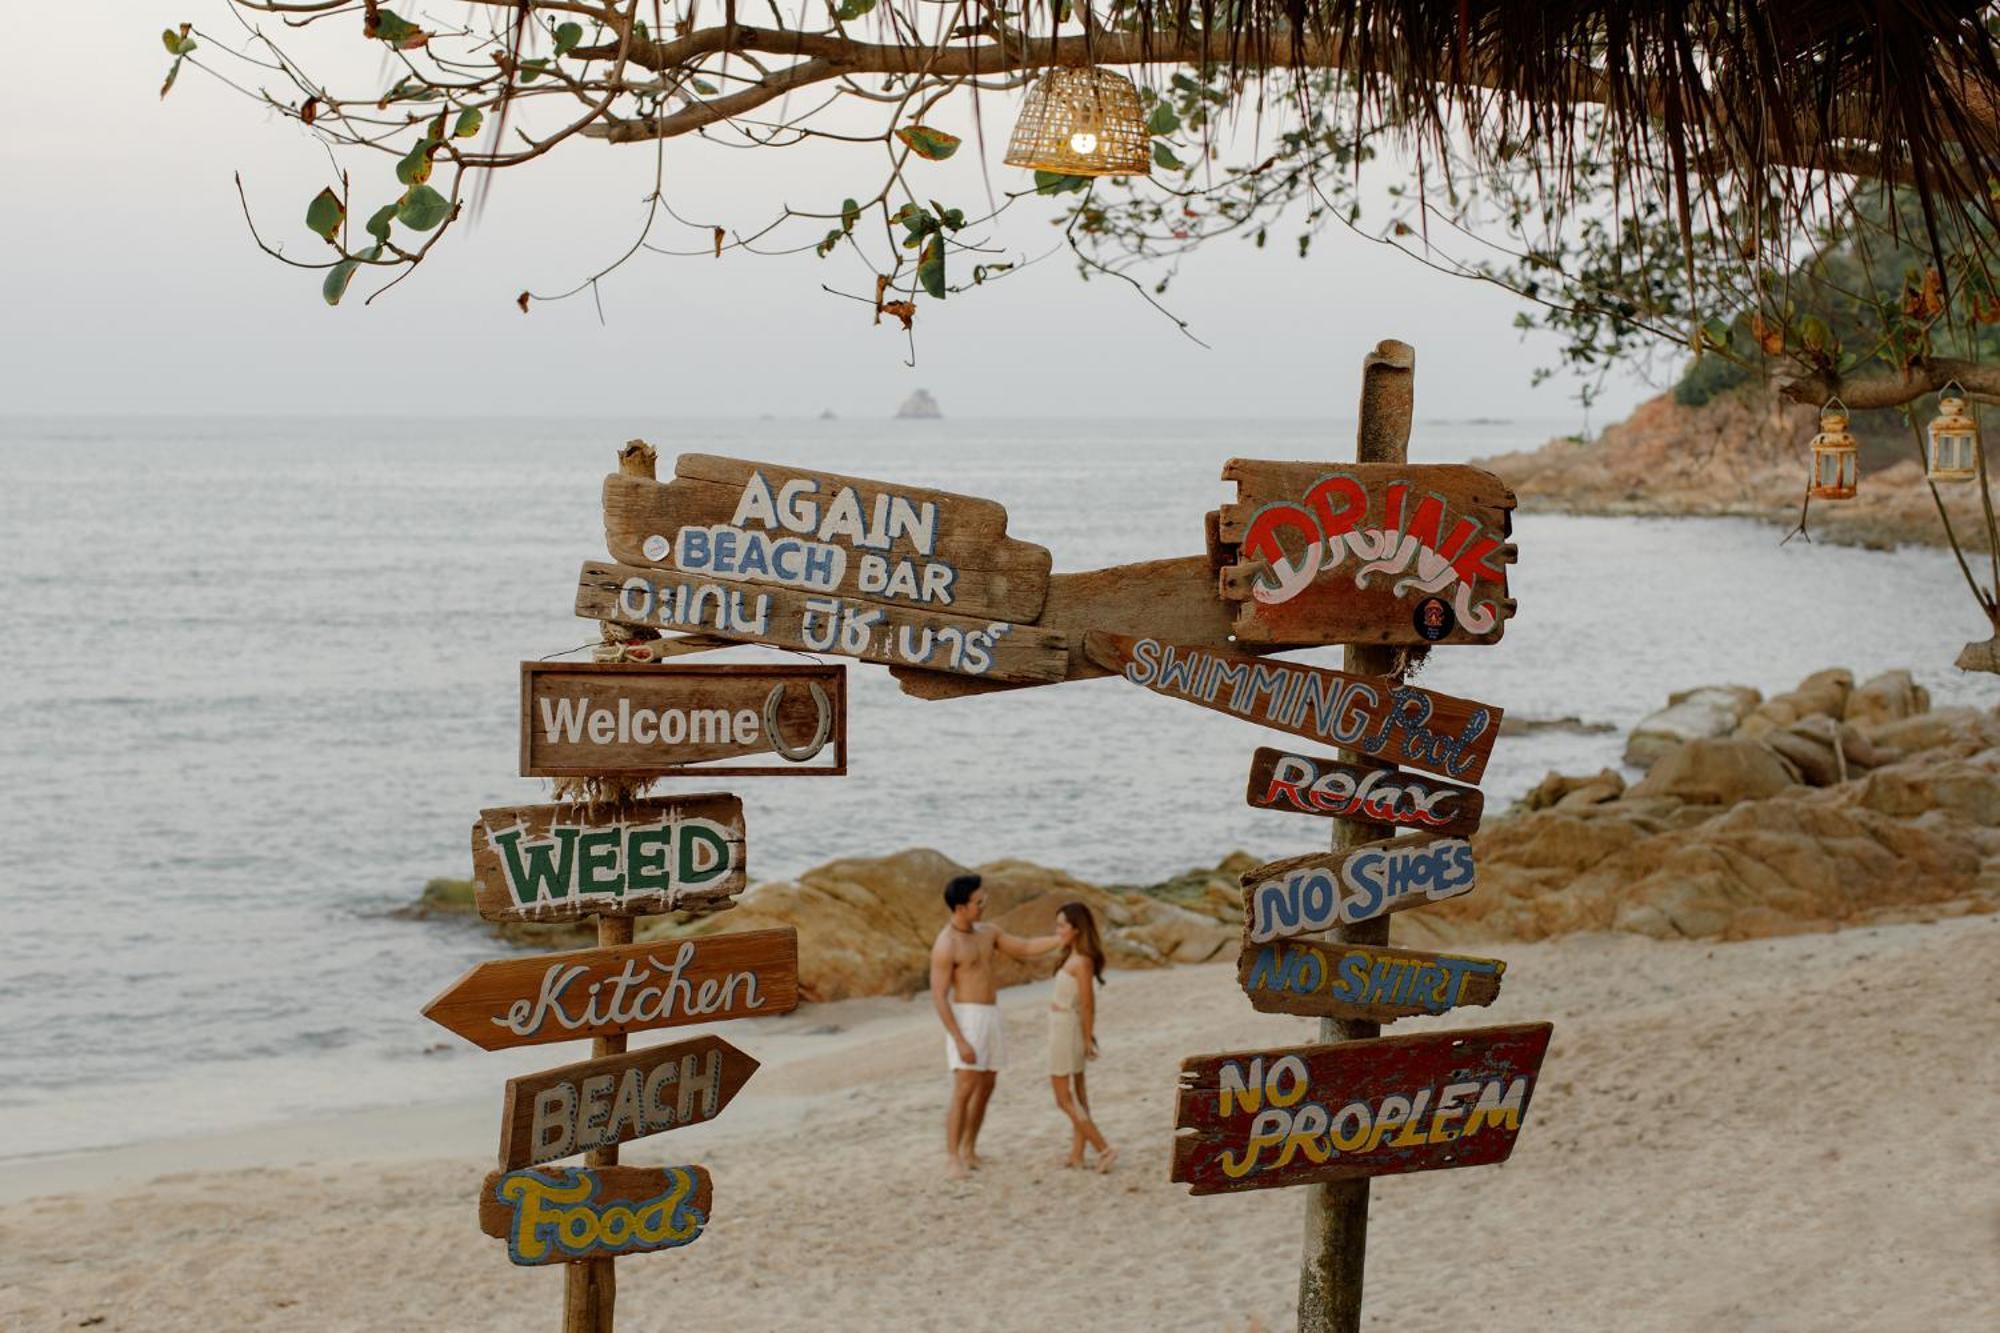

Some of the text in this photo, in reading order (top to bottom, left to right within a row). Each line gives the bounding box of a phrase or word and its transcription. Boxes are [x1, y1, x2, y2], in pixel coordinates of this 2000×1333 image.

[731, 470, 936, 556] AGAIN
[1242, 471, 1505, 635] DRINK
[675, 526, 956, 605] BEACH BAR
[540, 697, 760, 745] Welcome
[1127, 639, 1490, 777] SWIMMING Pool
[1265, 756, 1458, 826] Relax
[494, 822, 731, 905] WEED
[1253, 868, 1340, 943] NO
[491, 941, 765, 1036] Kitchen
[1247, 945, 1507, 1016] NO SHIRT
[532, 1049, 722, 1165] BEACH
[1218, 1055, 1309, 1117] NO
[500, 1166, 704, 1264] Food
